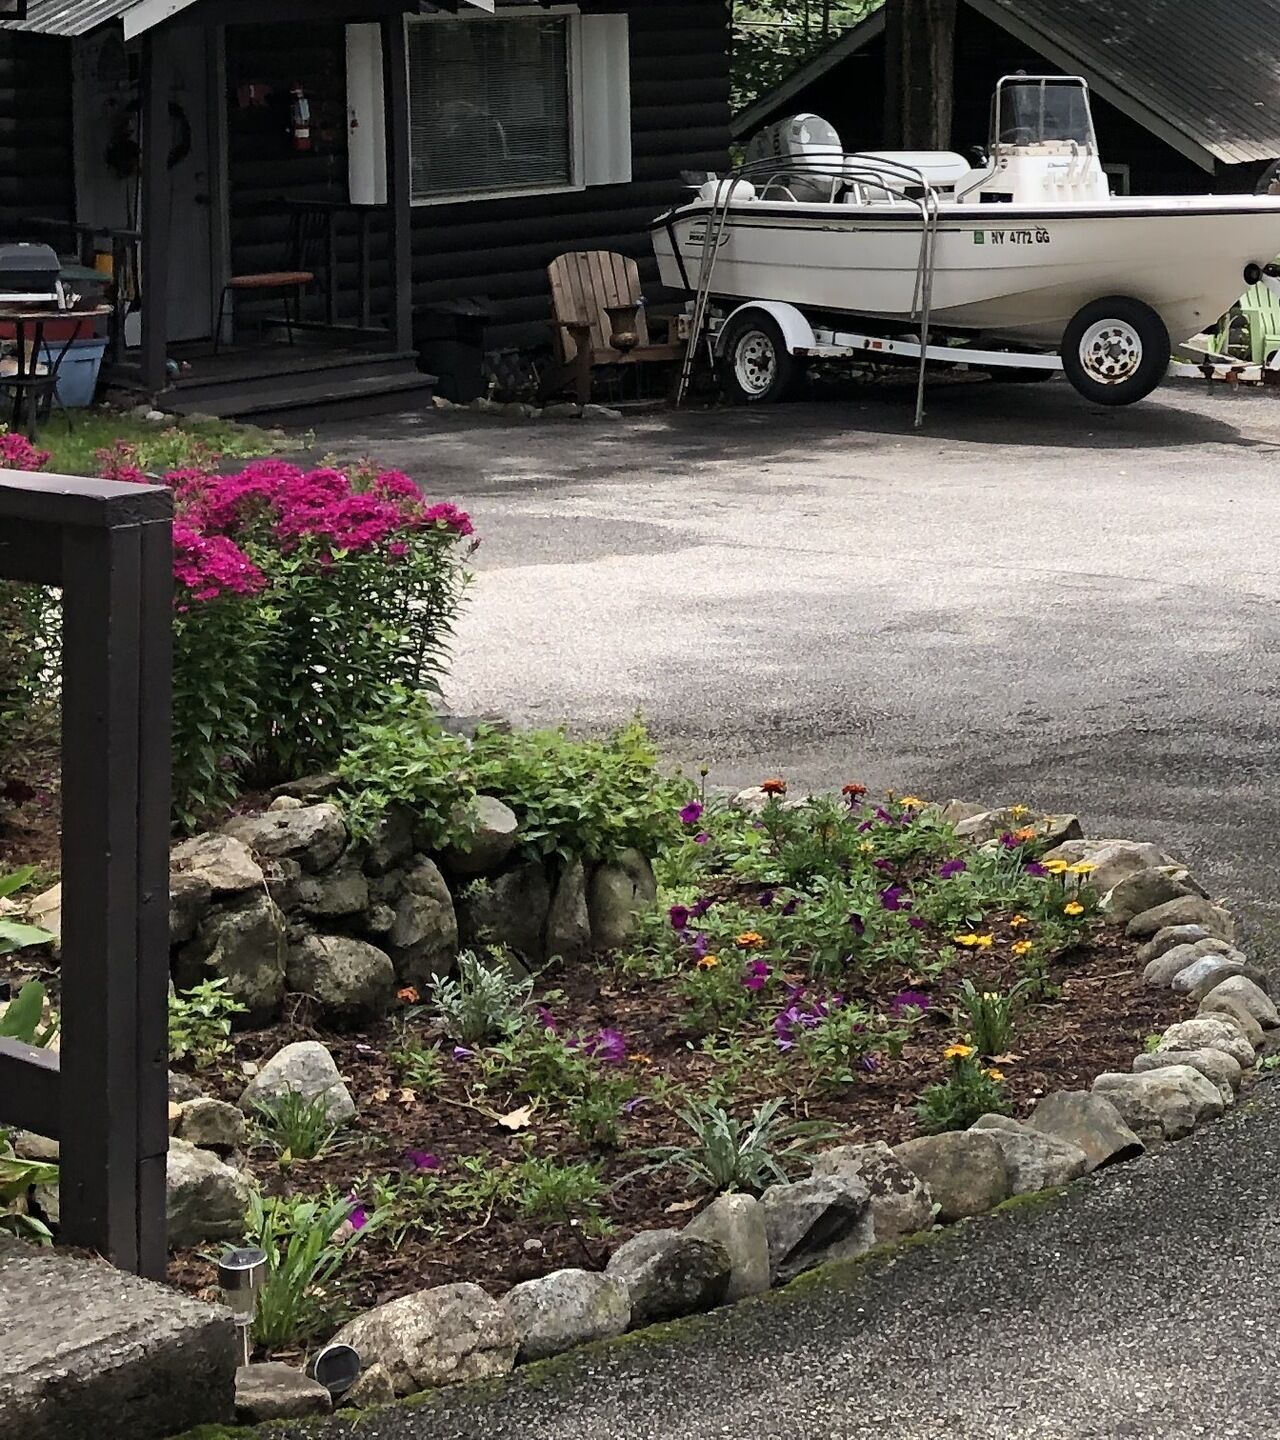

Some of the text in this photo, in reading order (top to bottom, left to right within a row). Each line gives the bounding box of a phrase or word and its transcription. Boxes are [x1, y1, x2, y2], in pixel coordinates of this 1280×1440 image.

[991, 230, 1050, 244] NY 4772 GG
